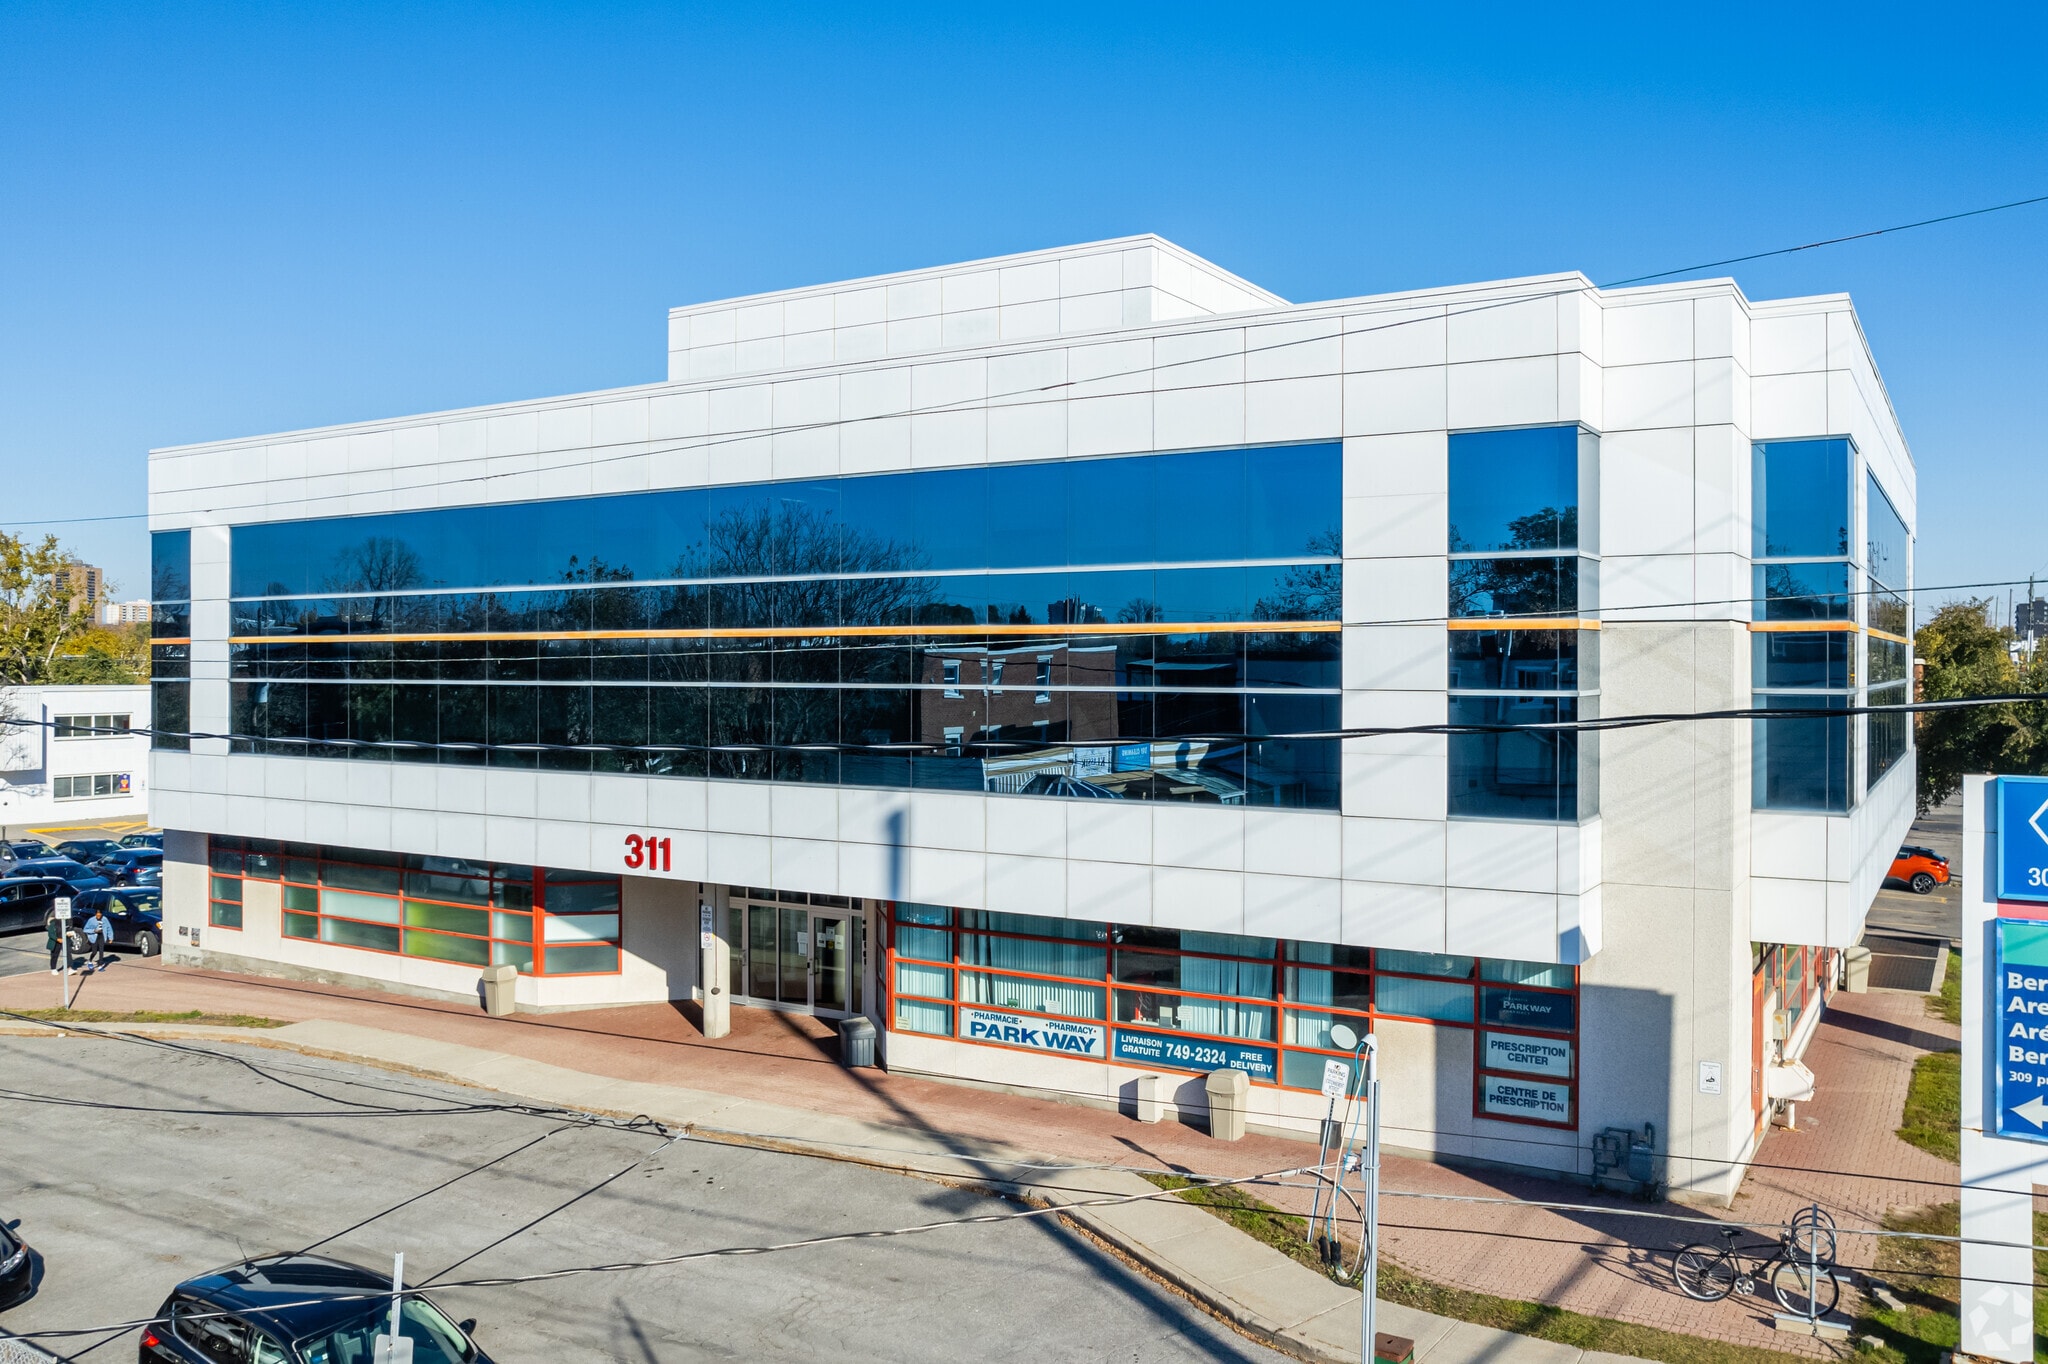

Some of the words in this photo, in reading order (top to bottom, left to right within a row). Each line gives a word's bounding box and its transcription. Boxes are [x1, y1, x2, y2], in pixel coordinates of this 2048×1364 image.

[624, 833, 671, 872] 311
[2007, 971, 2048, 992] Ber
[974, 1011, 1019, 1025] PHARMACIE
[1049, 1021, 1094, 1035] PHARMACY
[1121, 1034, 1163, 1048] LIVRAISON
[1121, 1045, 1161, 1057] GRATUITE
[1165, 1043, 1227, 1065] 749-2324
[1490, 1040, 1566, 1057] PRESCRIPTION
[2009, 1045, 2048, 1066] Ber
[1240, 1051, 1263, 1062] FREE
[1507, 1052, 1549, 1065] CENTER
[1230, 1060, 1273, 1073] DELIVERY
[2008, 1070, 2033, 1083] 309
[1497, 1085, 1539, 1099] CENTRE
[1542, 1090, 1556, 1101] DE
[1489, 1094, 1565, 1112] PRESCRIPTION
